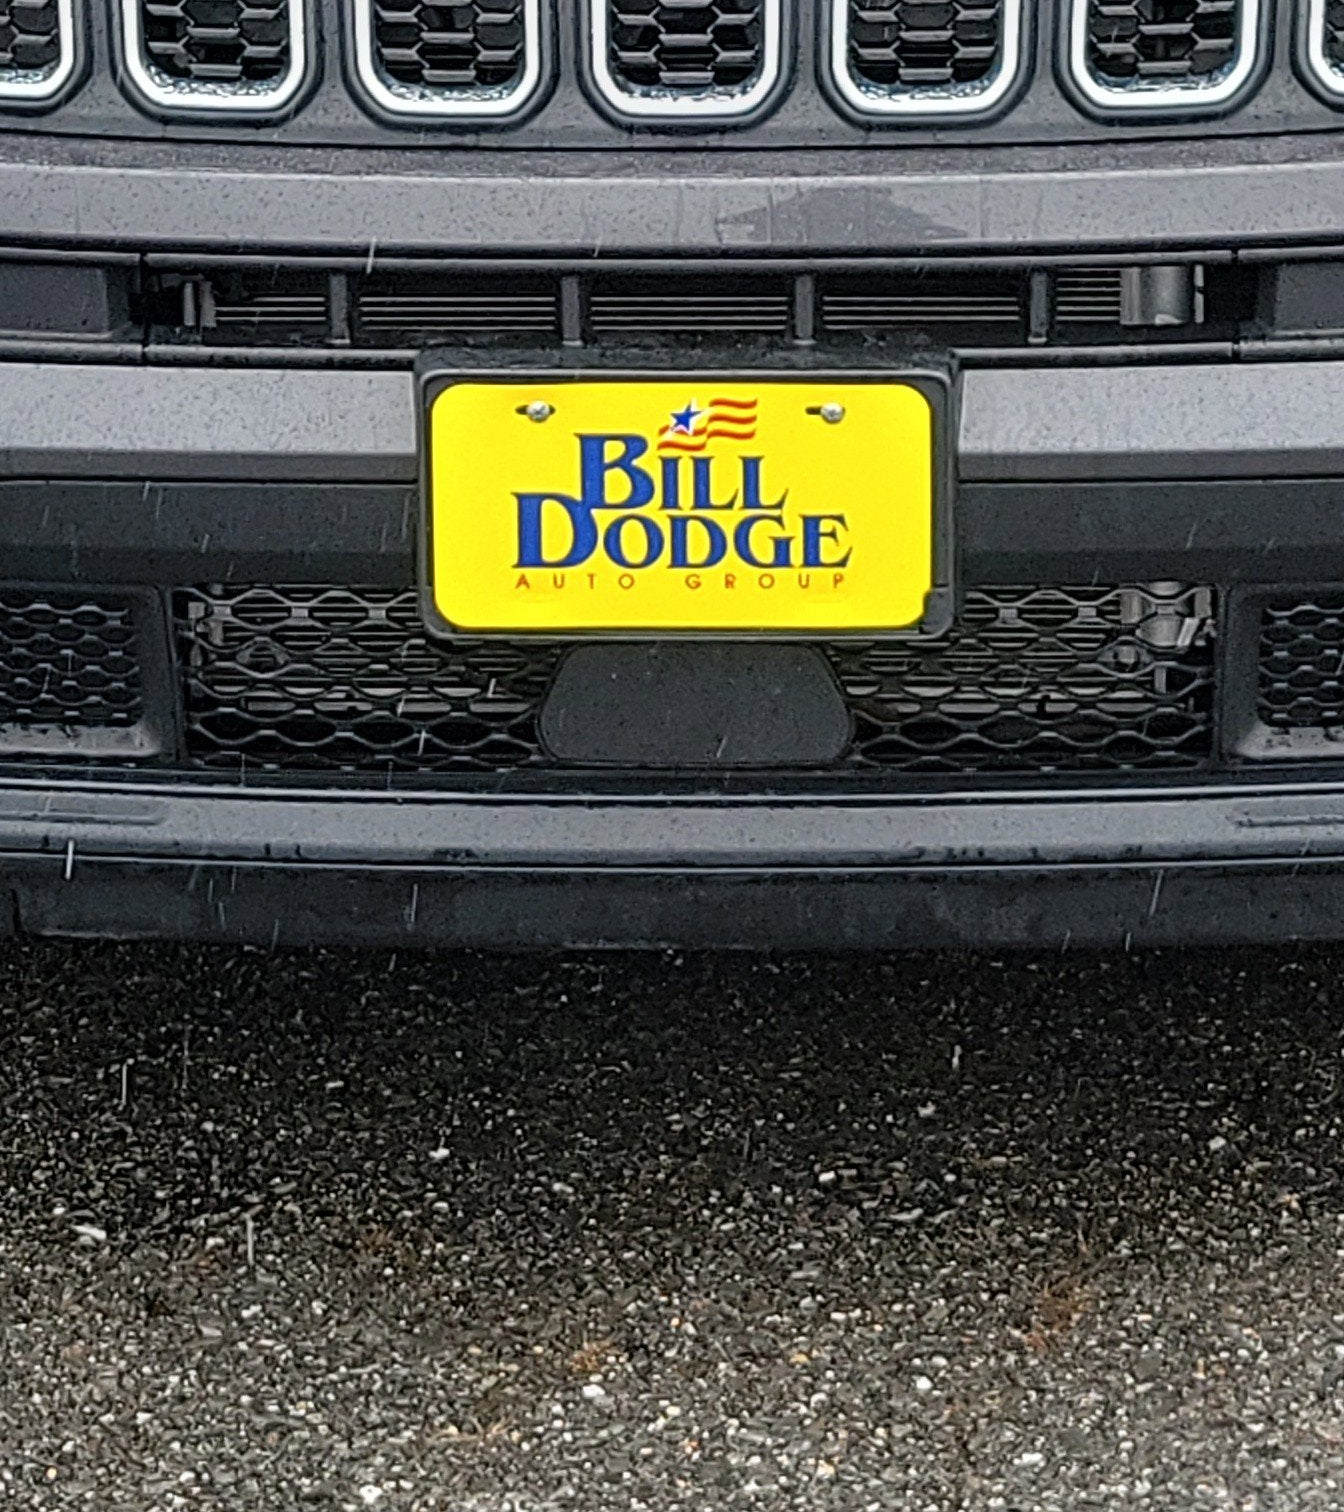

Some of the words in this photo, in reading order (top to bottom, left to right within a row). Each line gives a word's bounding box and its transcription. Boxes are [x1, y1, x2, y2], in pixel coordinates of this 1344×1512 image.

[574, 433, 789, 511] BILL
[511, 491, 853, 569] DODGE
[515, 573, 636, 590] AUTO
[685, 573, 846, 590] GROUP
